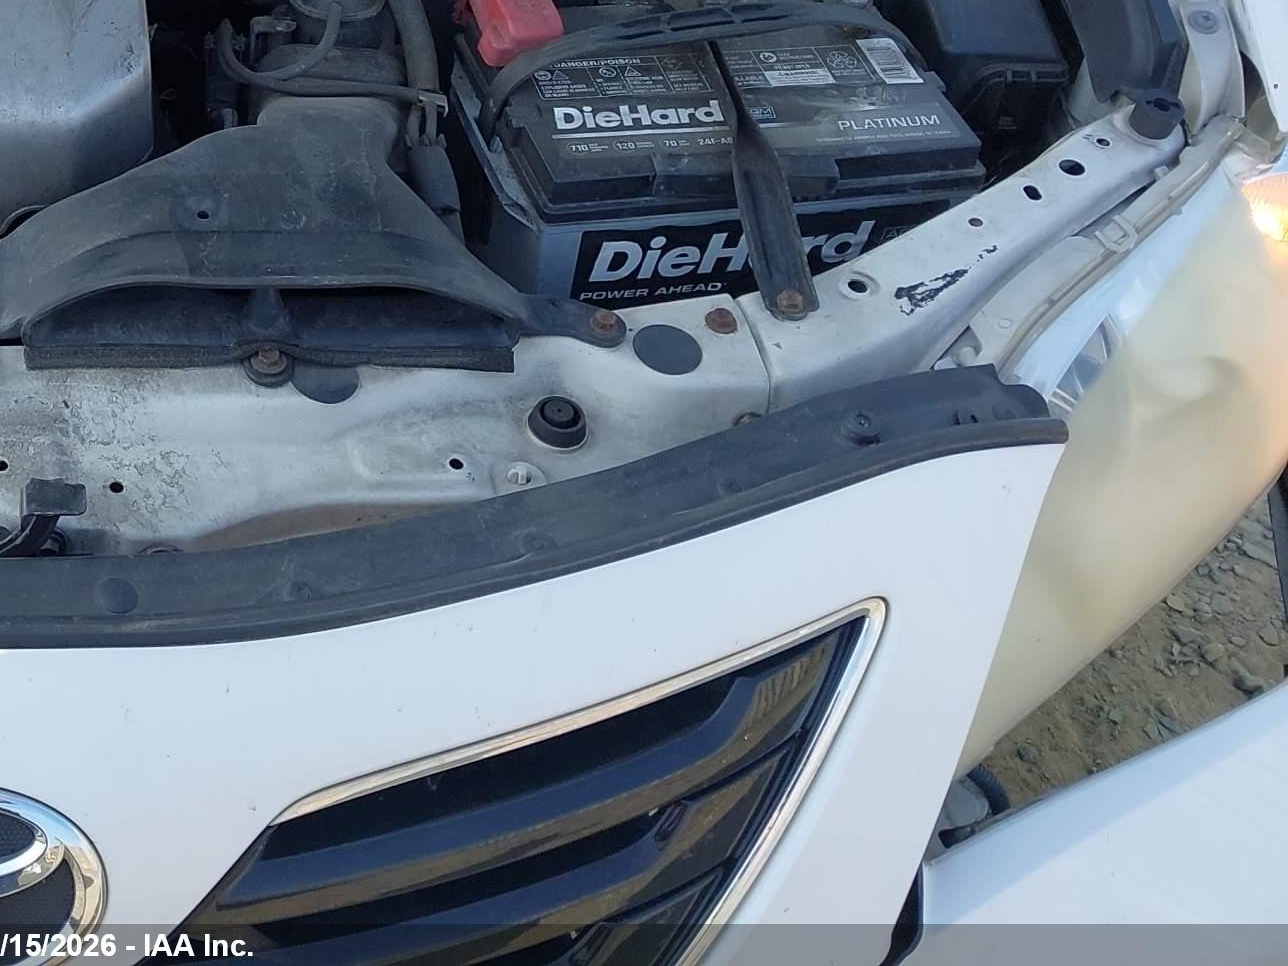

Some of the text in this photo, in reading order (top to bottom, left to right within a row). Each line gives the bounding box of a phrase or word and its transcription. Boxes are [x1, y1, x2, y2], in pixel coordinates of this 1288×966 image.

[552, 99, 725, 130] DieHard
[837, 114, 941, 131] PLATINUM
[569, 144, 589, 152] 710
[616, 142, 635, 150] 120
[588, 219, 876, 283] DieHrd
[579, 282, 722, 301] POWER AHEAD
